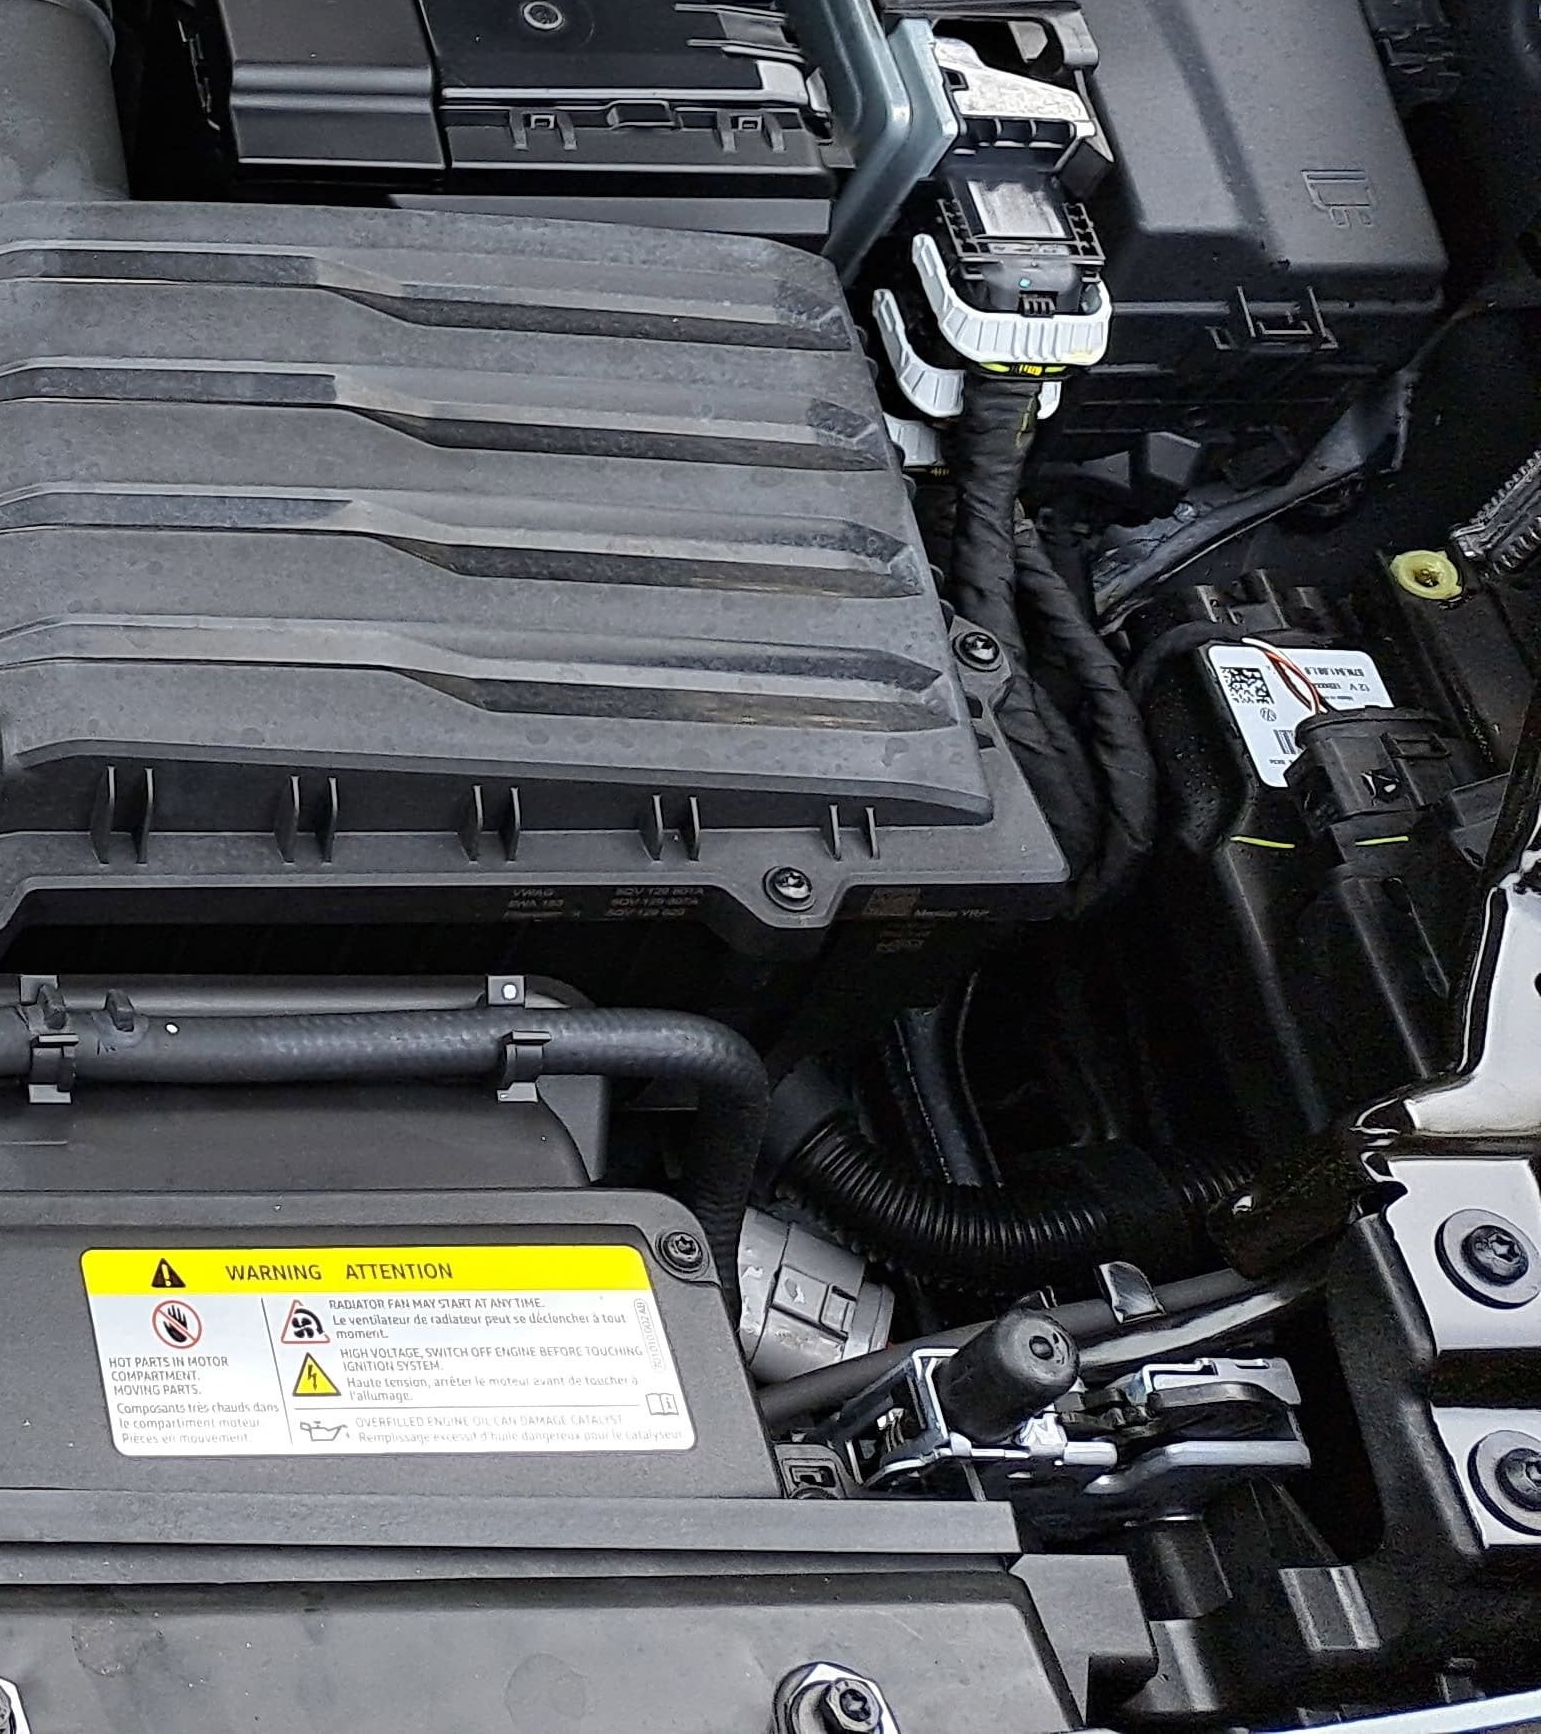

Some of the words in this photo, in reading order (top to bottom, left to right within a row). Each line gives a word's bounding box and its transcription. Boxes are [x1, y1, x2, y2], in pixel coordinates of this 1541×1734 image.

[225, 1264, 323, 1282] WARNING
[345, 1263, 453, 1281] ATTENTION
[329, 1298, 384, 1310] RADIATOR
[387, 1298, 411, 1309] FAN
[413, 1298, 436, 1309] MAY
[438, 1298, 472, 1309] START
[474, 1298, 488, 1309] AT
[332, 1315, 346, 1326] Le
[349, 1314, 411, 1326] ventilateur
[413, 1314, 428, 1325] de
[430, 1314, 482, 1325] radiateur
[485, 1315, 511, 1327] peut
[513, 1316, 527, 1324] se
[593, 1313, 600, 1324] à
[602, 1313, 627, 1324] tout
[336, 1330, 389, 1339] moment.
[340, 1348, 369, 1359] HIGH
[426, 1347, 468, 1358] SWITCH
[470, 1347, 492, 1358] OFF
[495, 1346, 536, 1357] ENGINE
[539, 1346, 583, 1357] BEFORE
[586, 1345, 644, 1357] TOUCHING
[108, 1356, 133, 1367] HOT
[135, 1356, 170, 1367] PARTS
[173, 1356, 185, 1367] IN
[188, 1355, 229, 1367] MOTOR
[343, 1361, 394, 1372] IGNITION
[112, 1371, 201, 1382] COMPARTMENT.
[347, 1377, 382, 1388] Haute
[474, 1376, 486, 1387] le
[114, 1384, 160, 1396] MOVING
[163, 1384, 202, 1395] PARTS.
[117, 1402, 185, 1417] Composants
[188, 1402, 209, 1413] très
[211, 1401, 251, 1413] chauds
[253, 1401, 280, 1413] dans
[119, 1417, 130, 1429] le
[132, 1417, 216, 1431] compartiment
[219, 1418, 261, 1429] moteur
[355, 1416, 425, 1429] OVERFILLED
